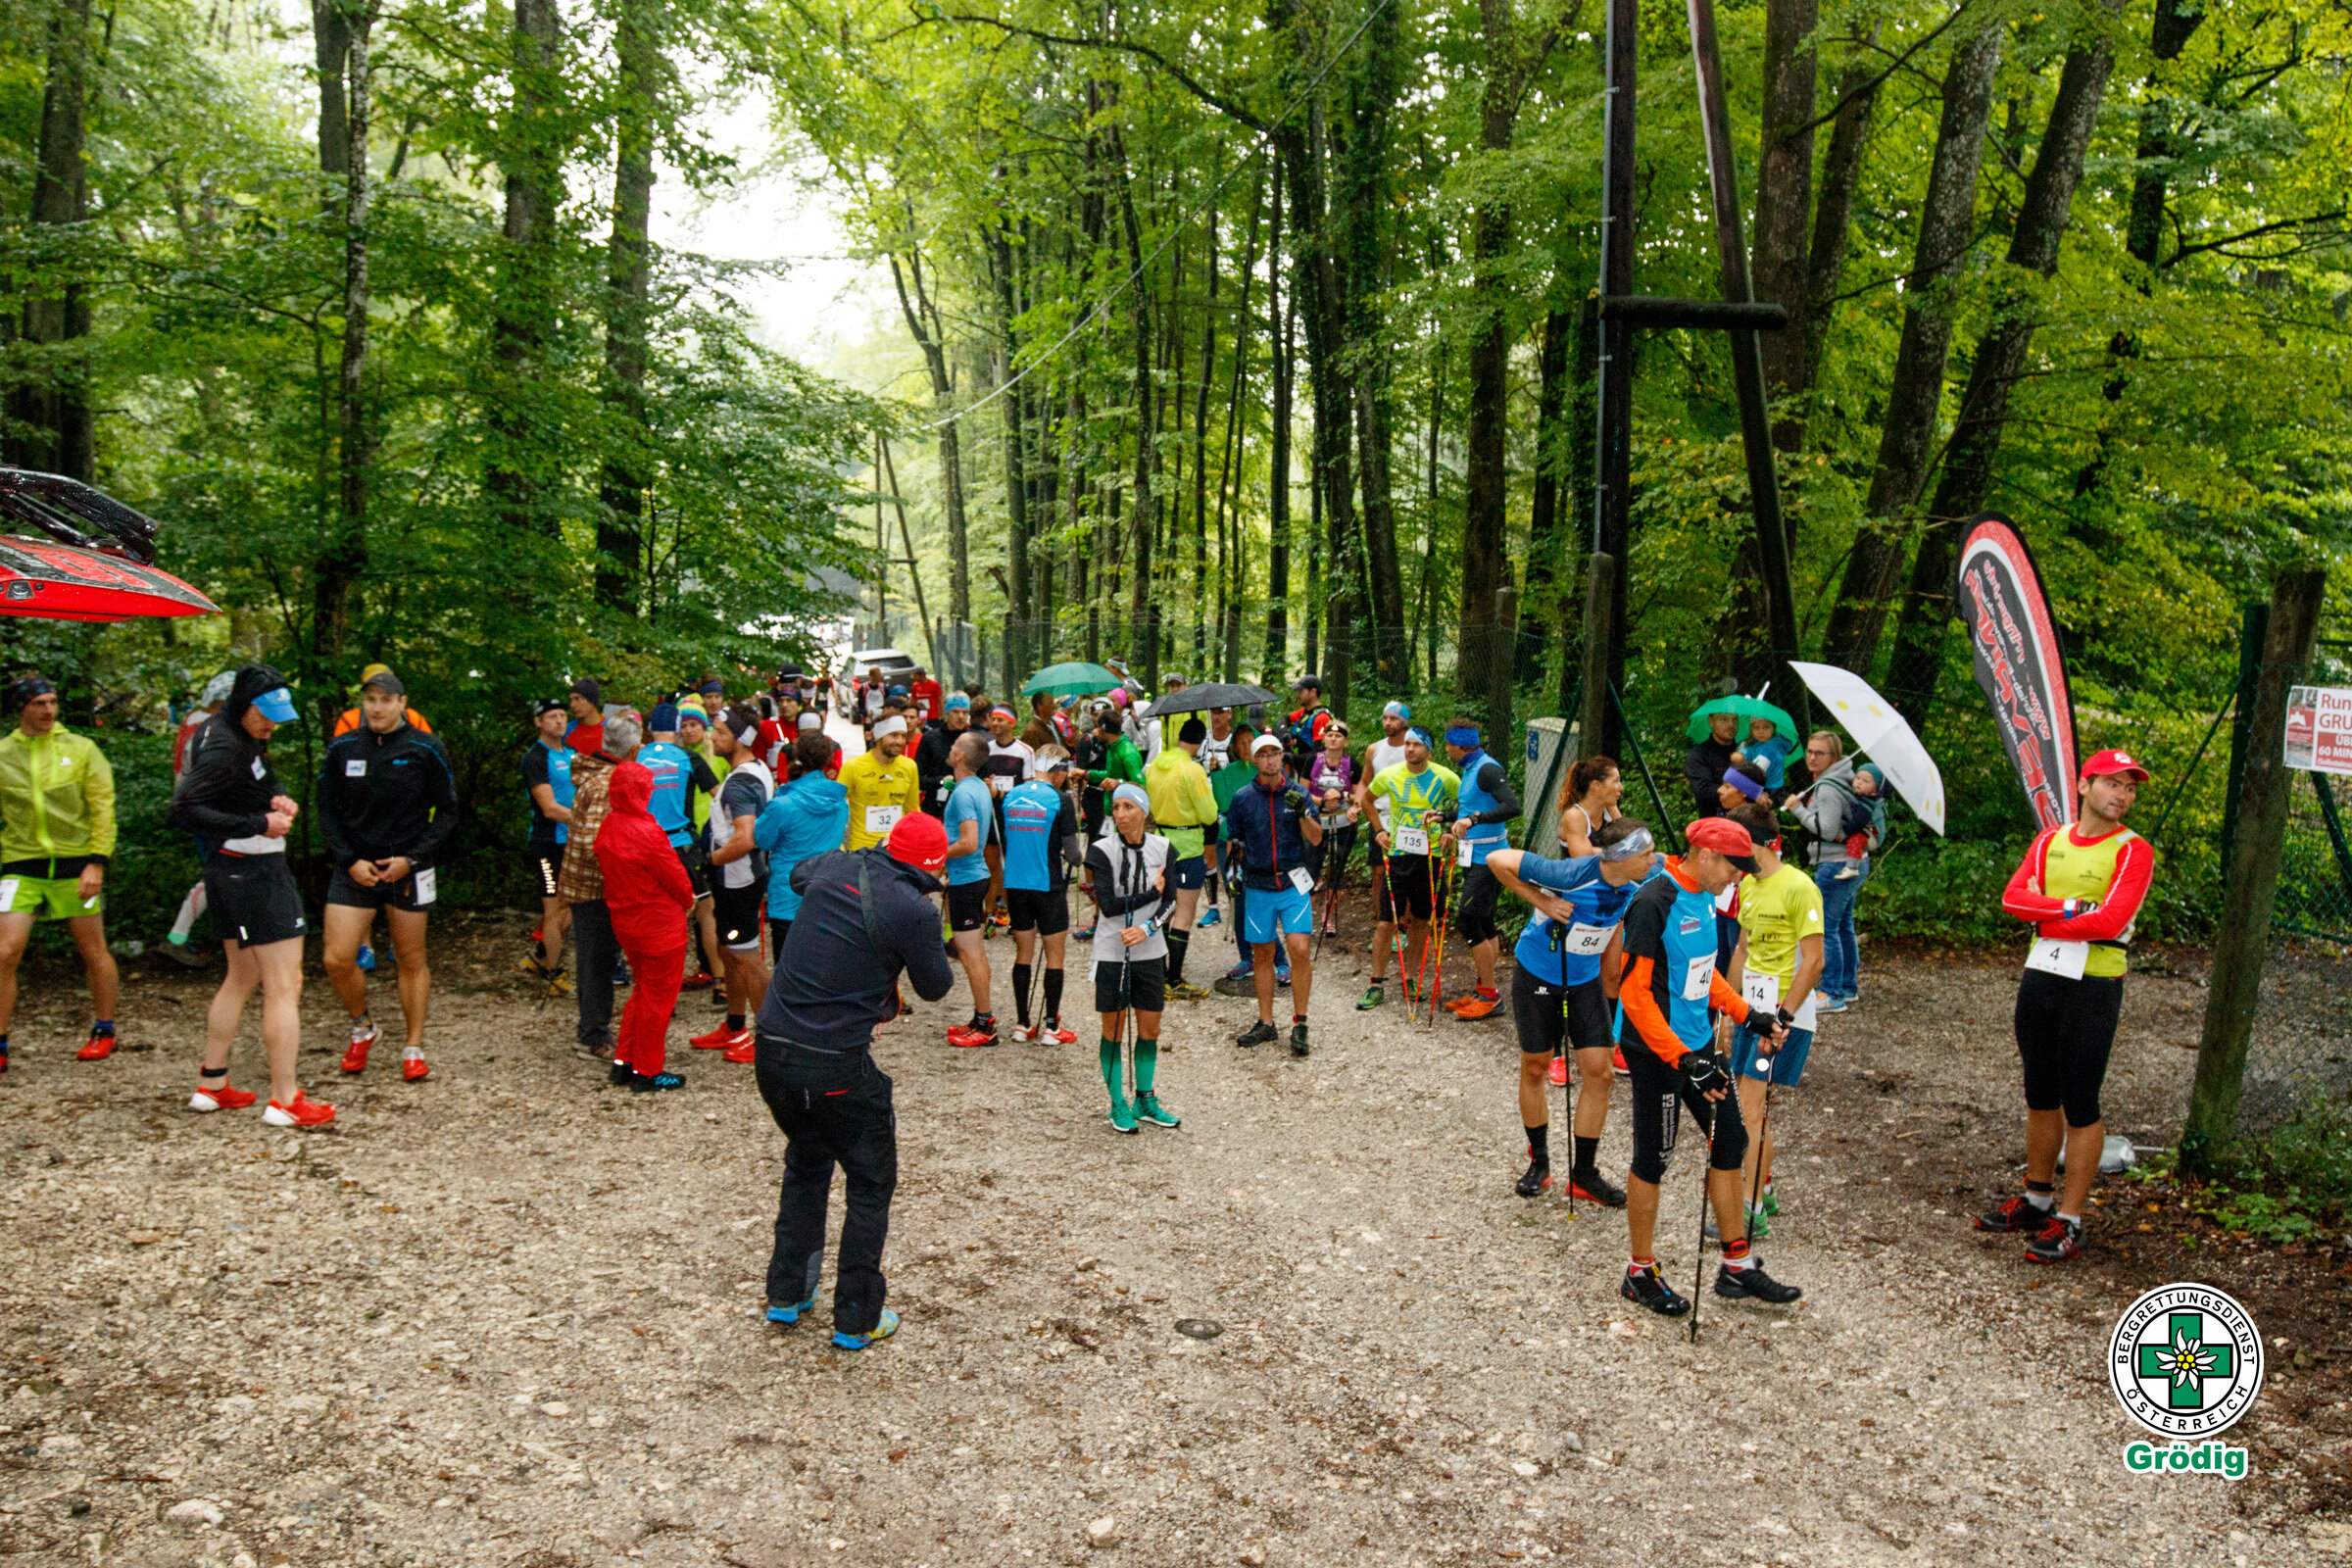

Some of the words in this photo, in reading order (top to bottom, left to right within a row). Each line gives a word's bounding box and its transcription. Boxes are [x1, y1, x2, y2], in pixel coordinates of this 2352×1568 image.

[2321, 693, 2351, 710] Run
[2335, 733, 2352, 747] ÜB
[2319, 745, 2331, 757] 60
[878, 814, 892, 825] 32
[1403, 836, 1422, 848] 135
[1581, 935, 1601, 947] 84
[2049, 947, 2061, 961] 4
[1699, 968, 1711, 985] 40
[1750, 985, 1765, 1001] 14
